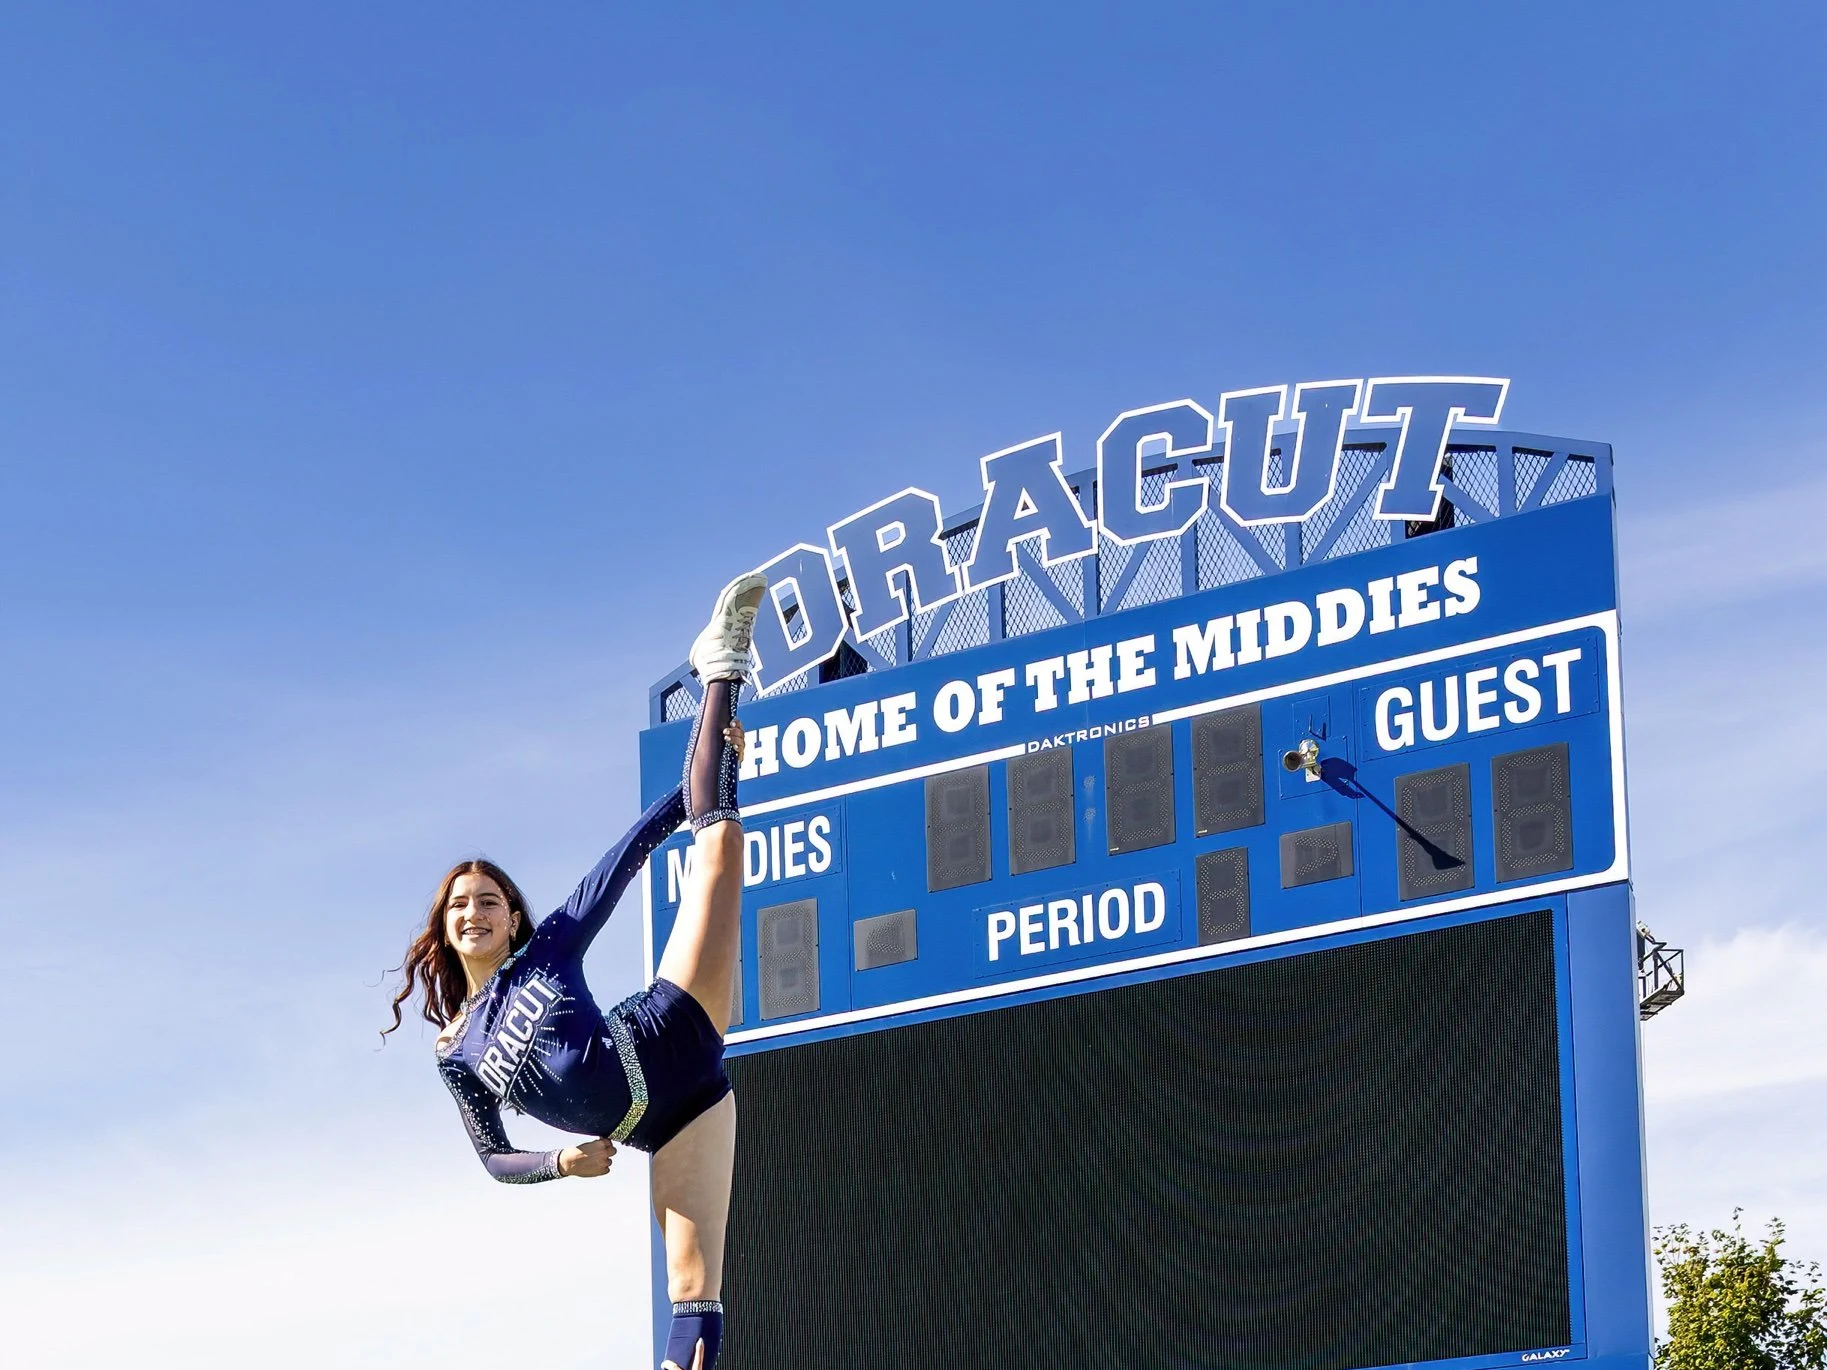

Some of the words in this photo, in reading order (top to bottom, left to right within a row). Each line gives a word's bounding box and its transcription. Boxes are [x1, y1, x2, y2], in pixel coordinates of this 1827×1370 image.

[746, 375, 1510, 697] DRACUT
[740, 691, 918, 781] HOME
[932, 662, 1027, 730] OF
[1025, 635, 1156, 711] THE
[1173, 556, 1481, 680] MIDDIES
[1373, 647, 1583, 753] GUEST
[1027, 715, 1150, 754] DAKTRONICS
[667, 815, 832, 904] MDIES
[986, 881, 1166, 963] PERIOD
[477, 973, 558, 1099] DRACUT
